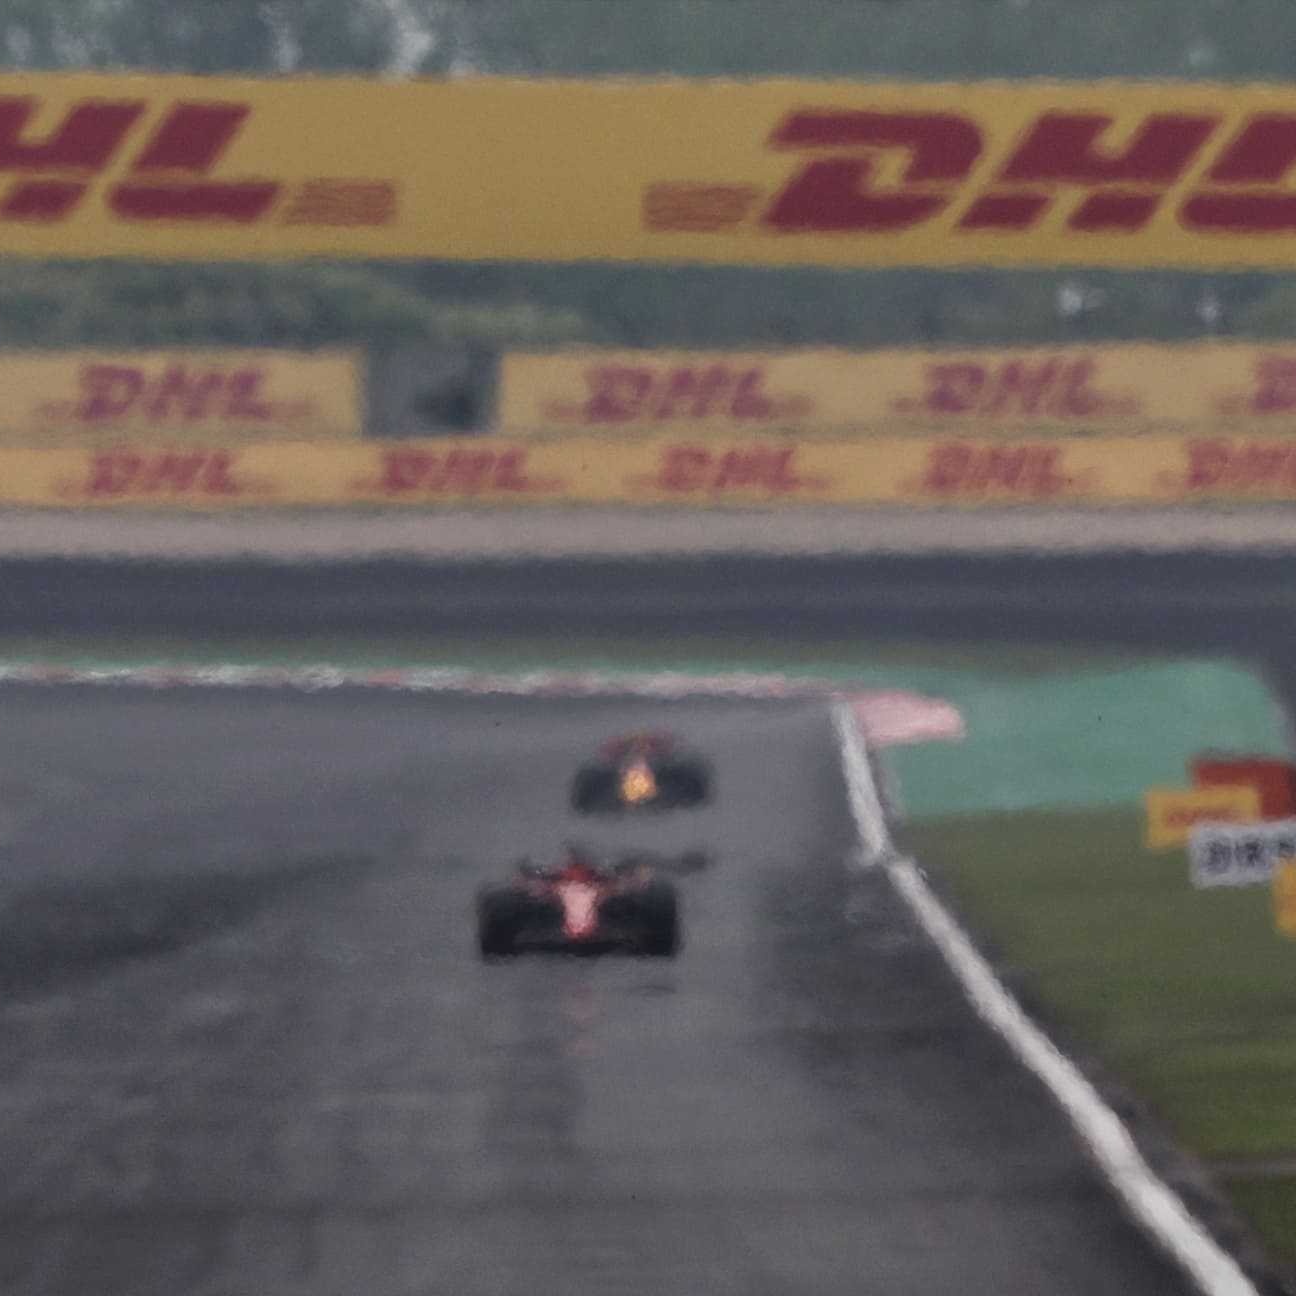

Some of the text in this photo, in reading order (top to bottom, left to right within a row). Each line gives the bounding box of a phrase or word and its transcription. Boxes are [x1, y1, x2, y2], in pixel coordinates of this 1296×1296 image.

[80, 364, 270, 422] DHL
[583, 363, 772, 423] DHL
[926, 357, 1104, 417] DHL
[88, 450, 242, 495] DHL
[379, 449, 526, 493] DHL
[657, 447, 796, 491] DHL
[924, 446, 1068, 492] DHL
